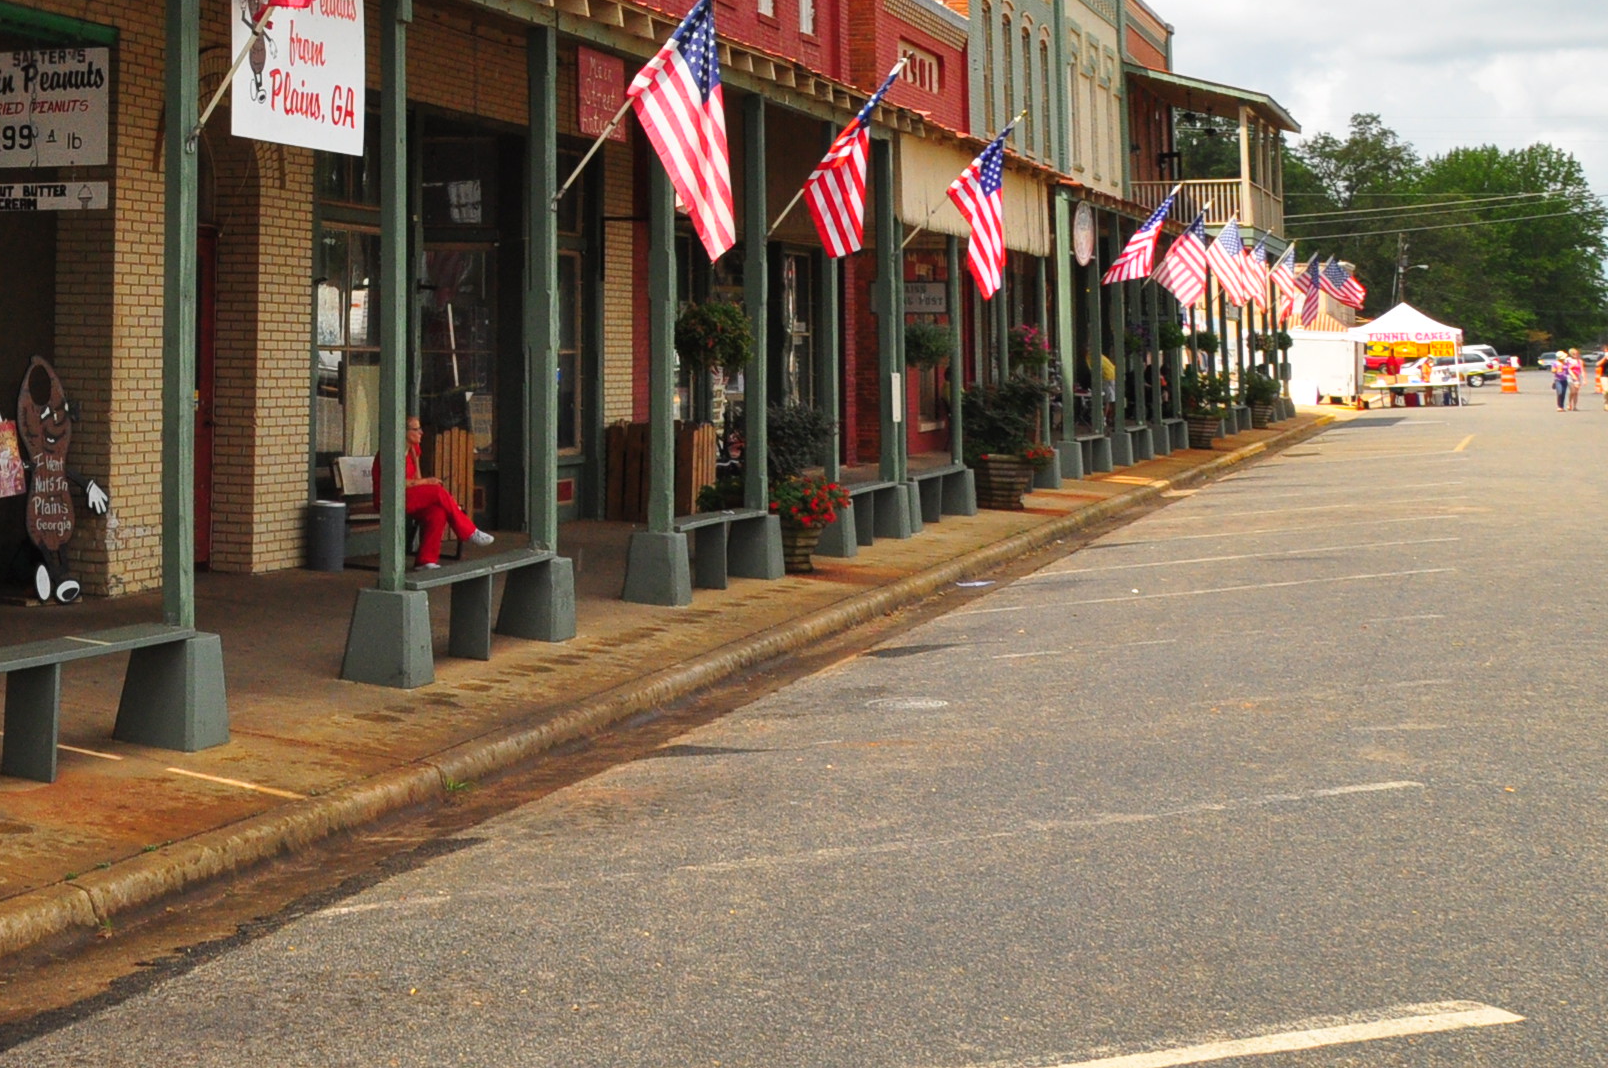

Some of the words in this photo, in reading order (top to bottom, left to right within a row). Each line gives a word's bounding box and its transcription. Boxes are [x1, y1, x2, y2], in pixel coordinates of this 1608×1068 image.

[288, 19, 327, 67] from
[21, 61, 105, 94] Peanuts
[31, 99, 90, 115] PEANUTS
[269, 68, 326, 124] Plains,
[331, 84, 356, 130] GA
[67, 132, 83, 150] lb
[22, 184, 67, 198] BUTTER
[45, 455, 65, 472] Went
[56, 476, 69, 492] In
[32, 496, 70, 516] Plains
[36, 517, 73, 537] Georgia
